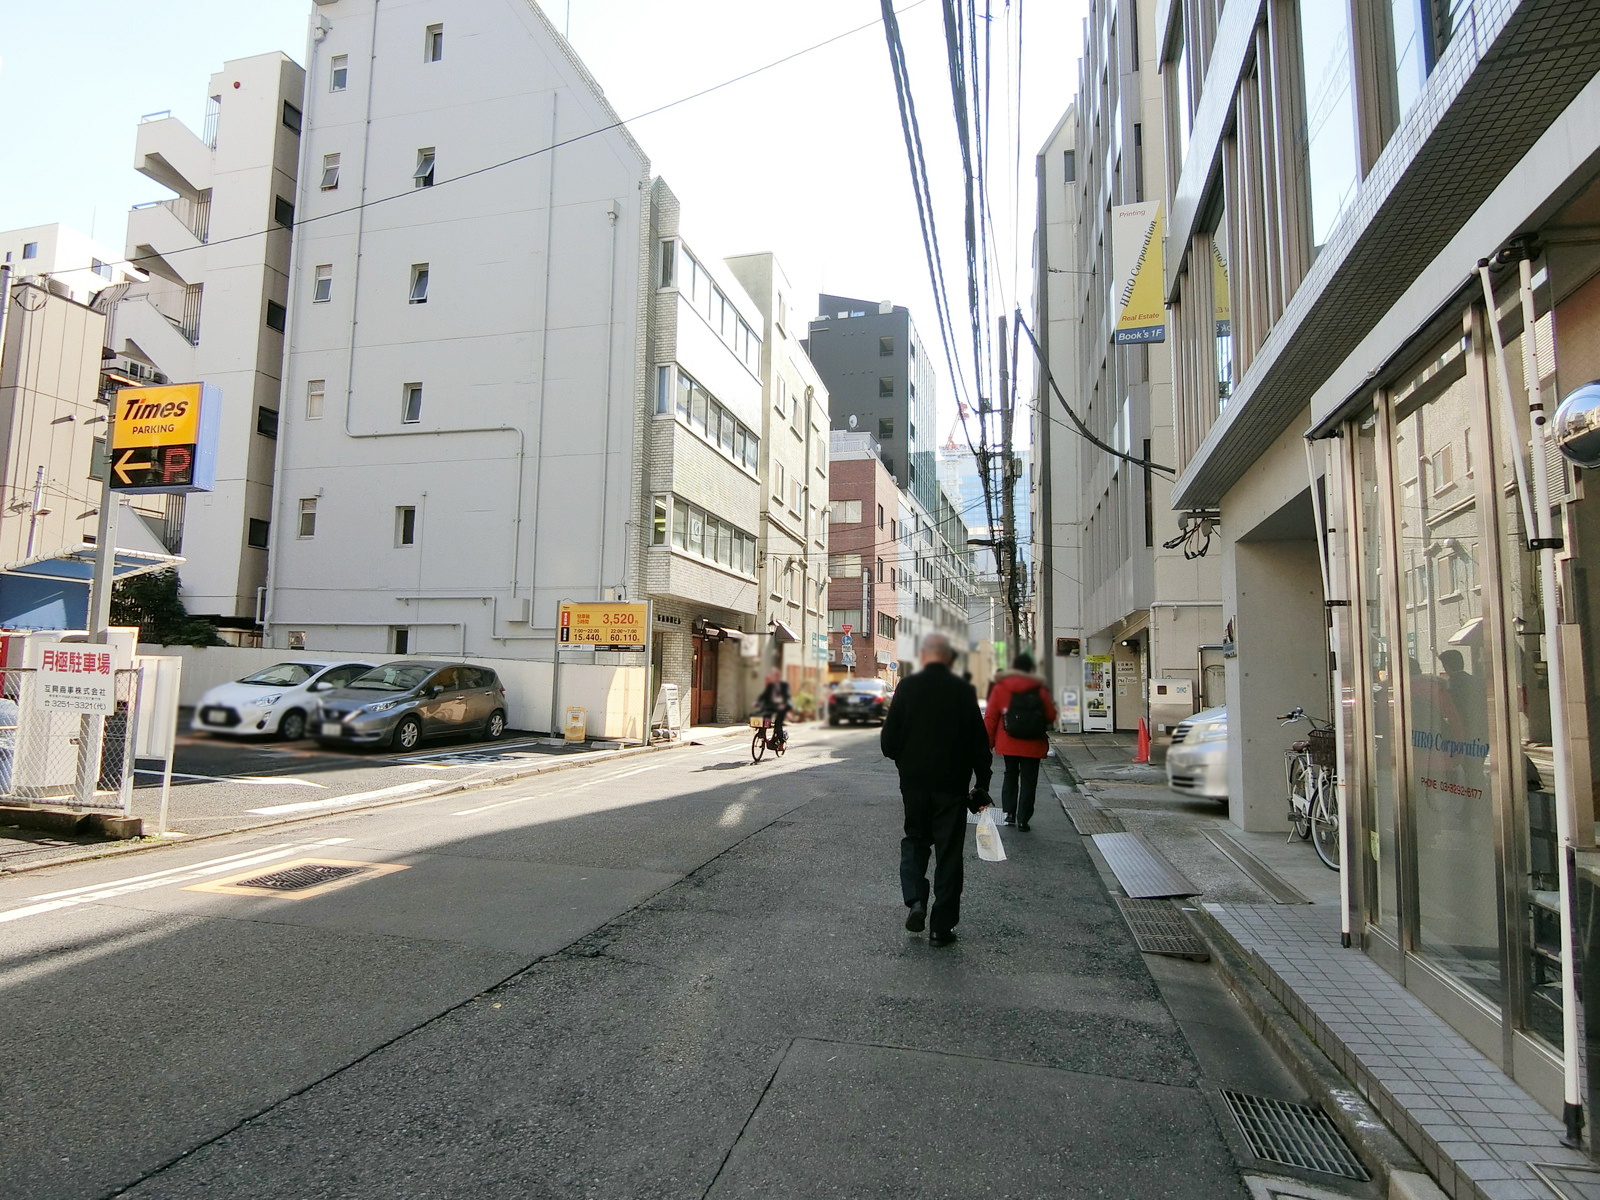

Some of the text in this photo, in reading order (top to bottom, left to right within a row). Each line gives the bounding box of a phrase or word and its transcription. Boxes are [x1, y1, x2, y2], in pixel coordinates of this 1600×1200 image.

[1119, 209, 1146, 218] Printing
[1119, 220, 1157, 307] HIRO Corporation
[1121, 312, 1160, 322] Real Estate
[1118, 328, 1162, 341] Book's 1F
[123, 399, 188, 421] Times
[132, 424, 175, 435] PARKING
[162, 447, 191, 483] P
[42, 650, 110, 675] 月極駐車場
[1412, 729, 1433, 749] HIRO
[1420, 777, 1438, 789] PHONE
